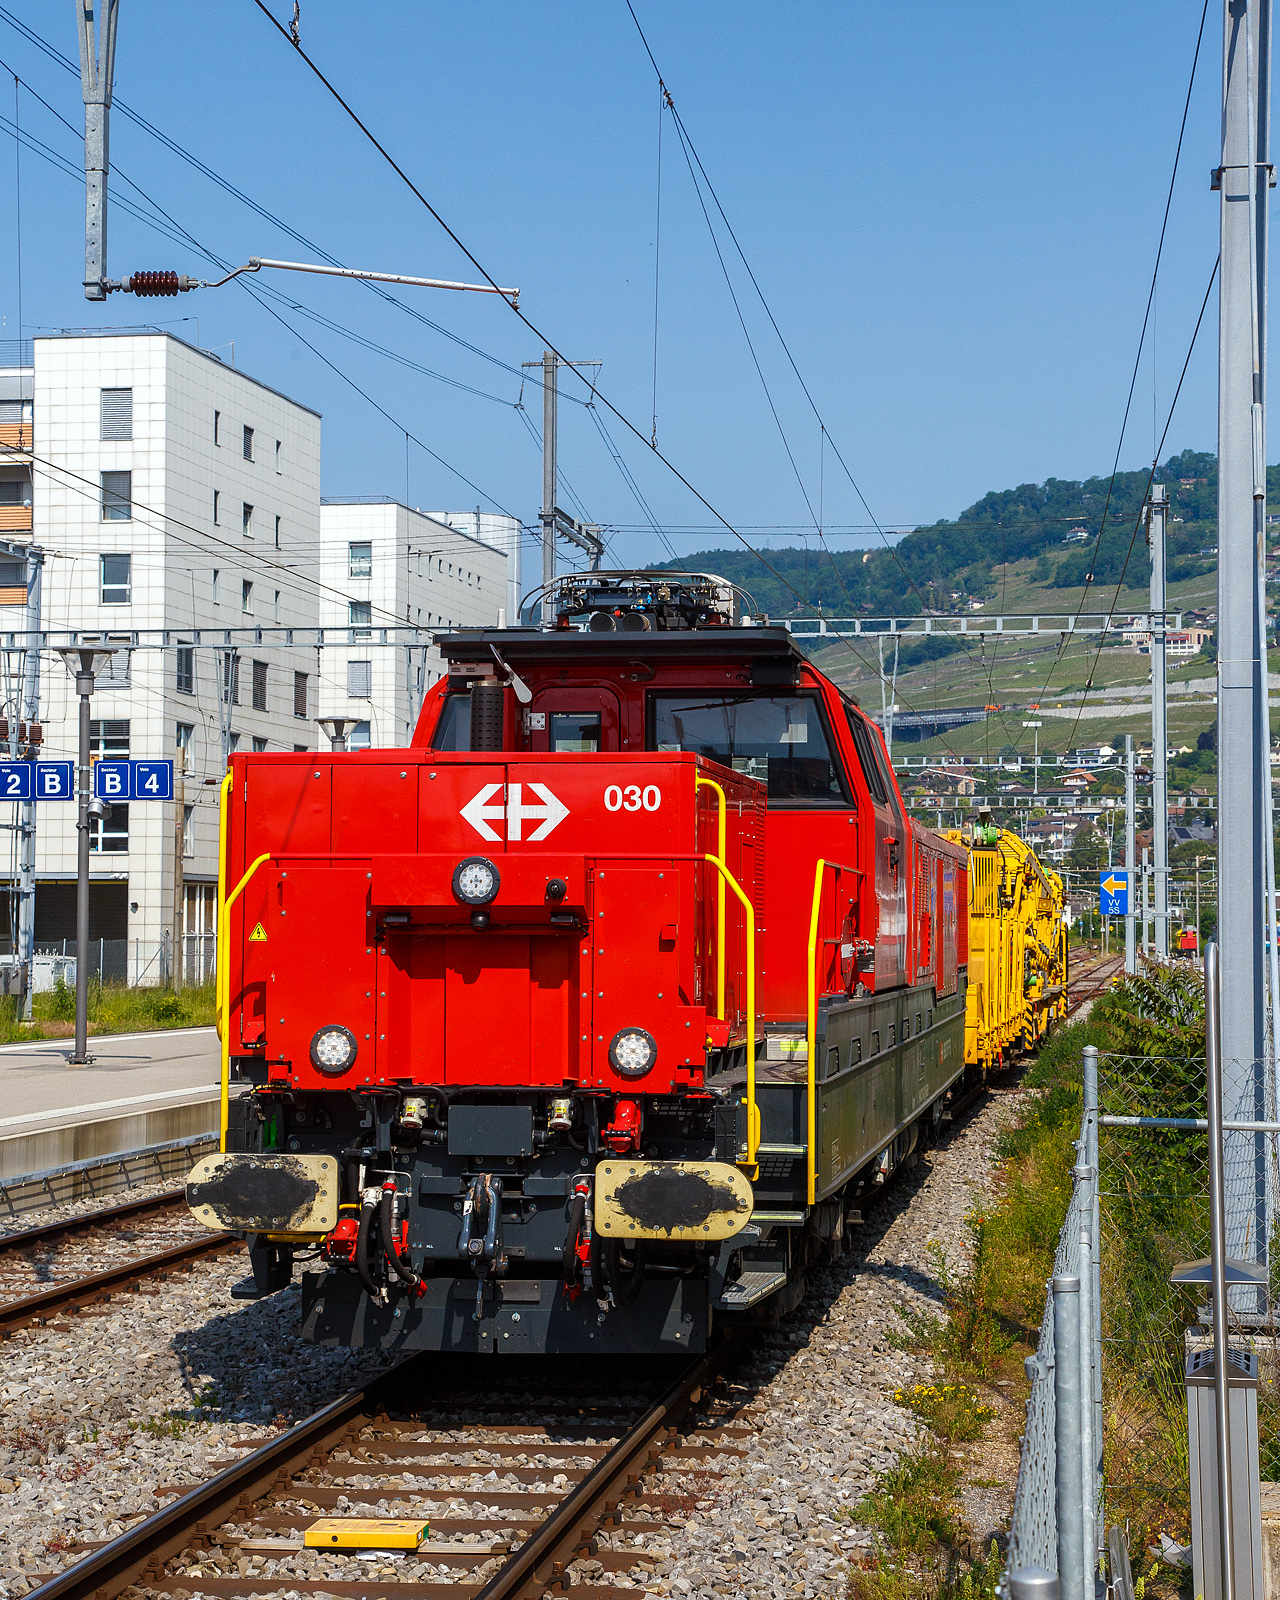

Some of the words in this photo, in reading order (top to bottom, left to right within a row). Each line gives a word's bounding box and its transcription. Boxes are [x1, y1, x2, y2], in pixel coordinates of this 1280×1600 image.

[6, 774, 21, 794] 2
[44, 774, 62, 794] B
[105, 773, 122, 794] B
[144, 773, 160, 794] 4
[604, 785, 661, 812] 030
